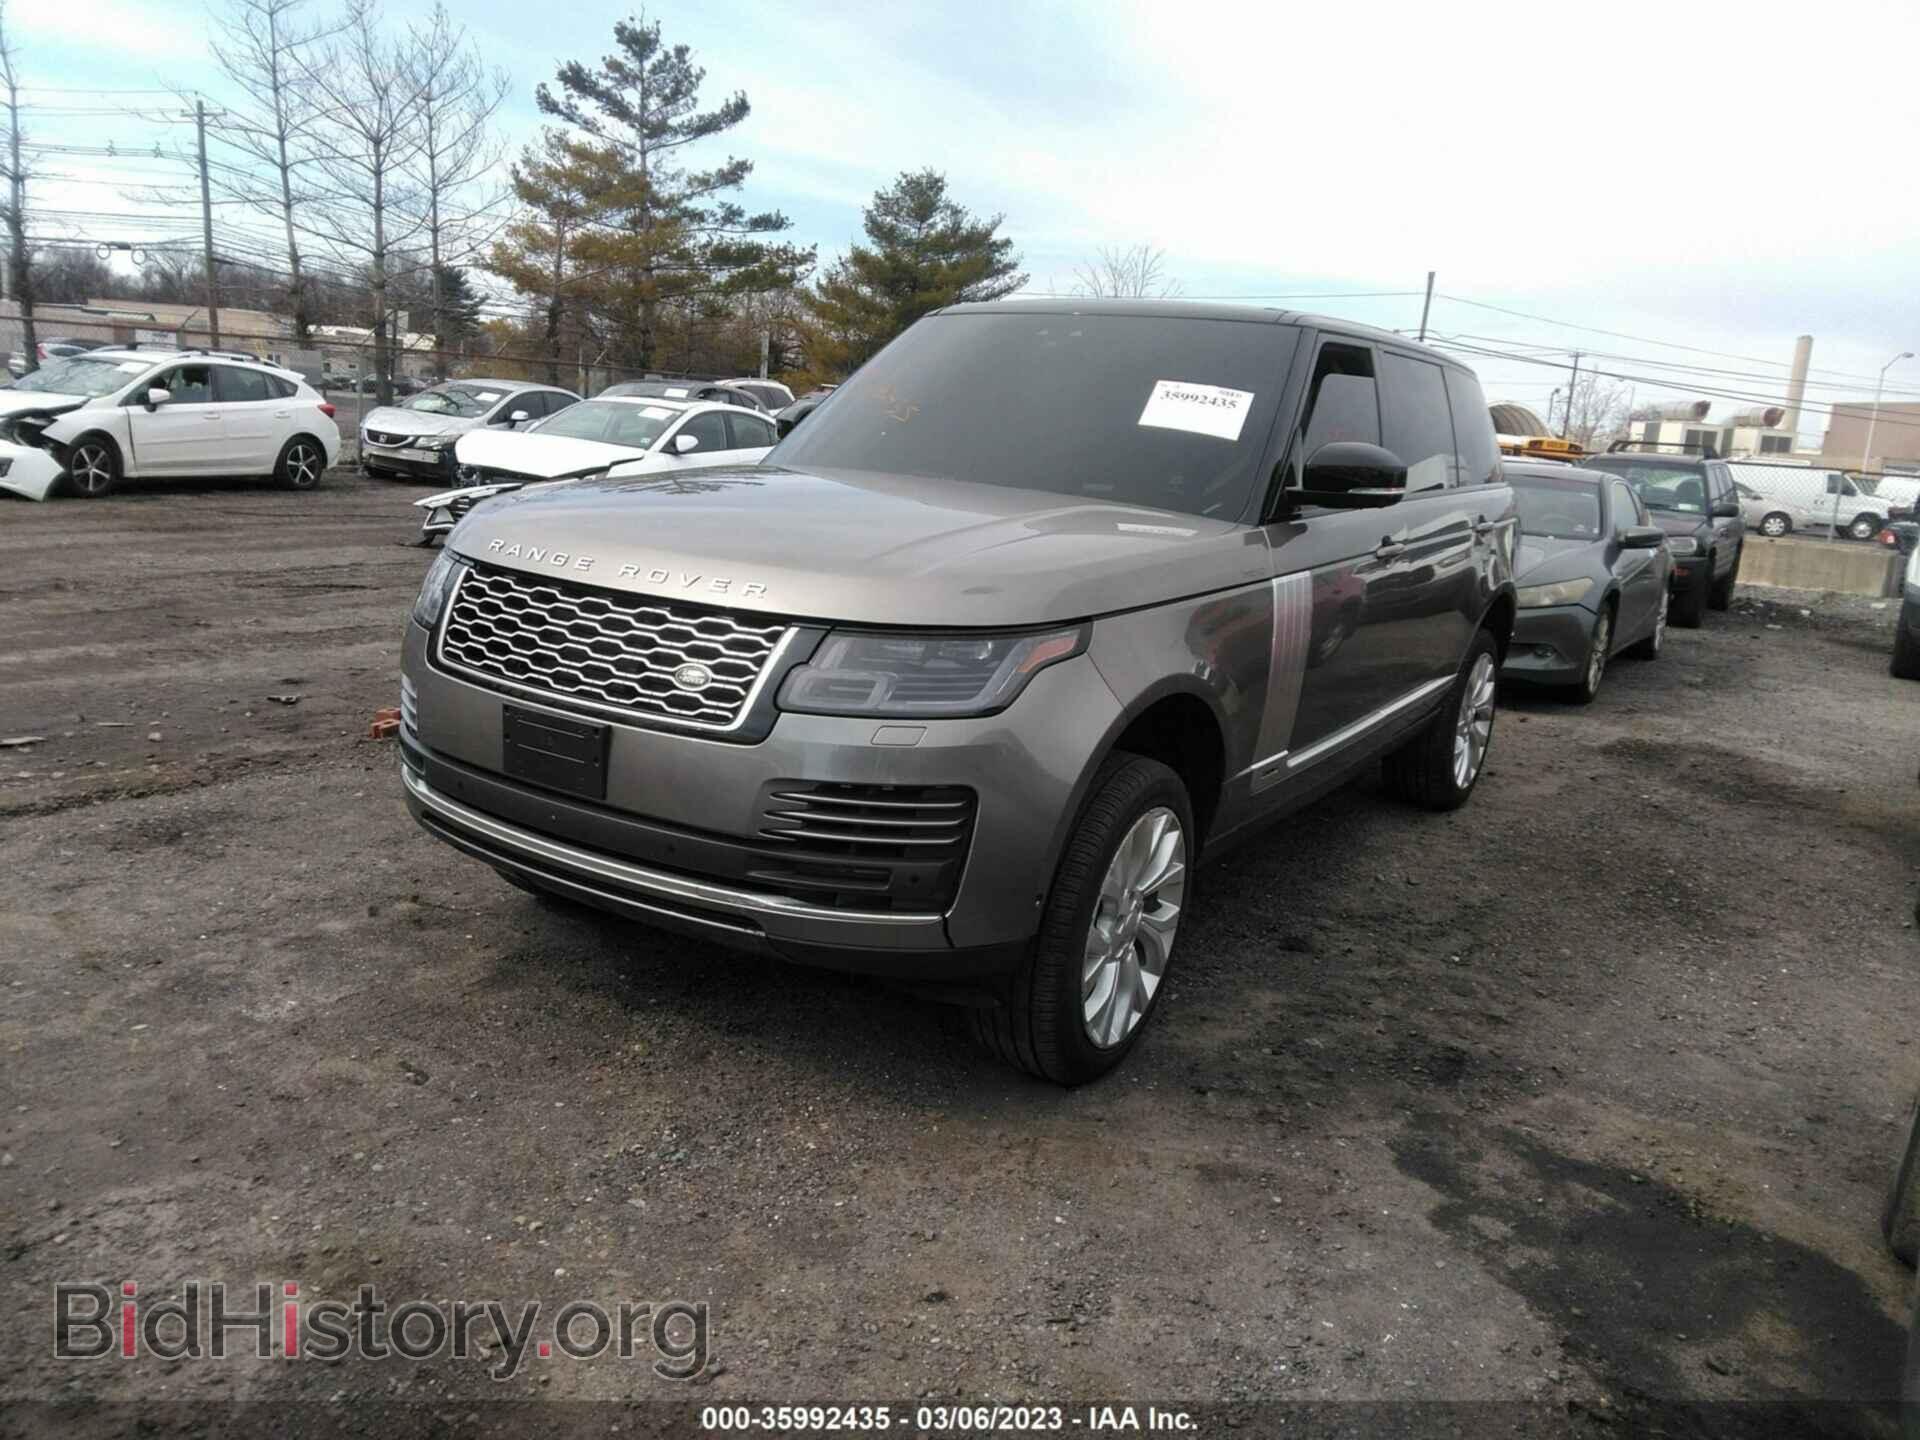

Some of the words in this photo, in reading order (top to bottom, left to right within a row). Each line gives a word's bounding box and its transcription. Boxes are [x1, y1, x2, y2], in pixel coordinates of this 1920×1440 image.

[1160, 390, 1238, 409] 35992435
[488, 538, 594, 571] RANGE
[618, 563, 768, 598] ROVER
